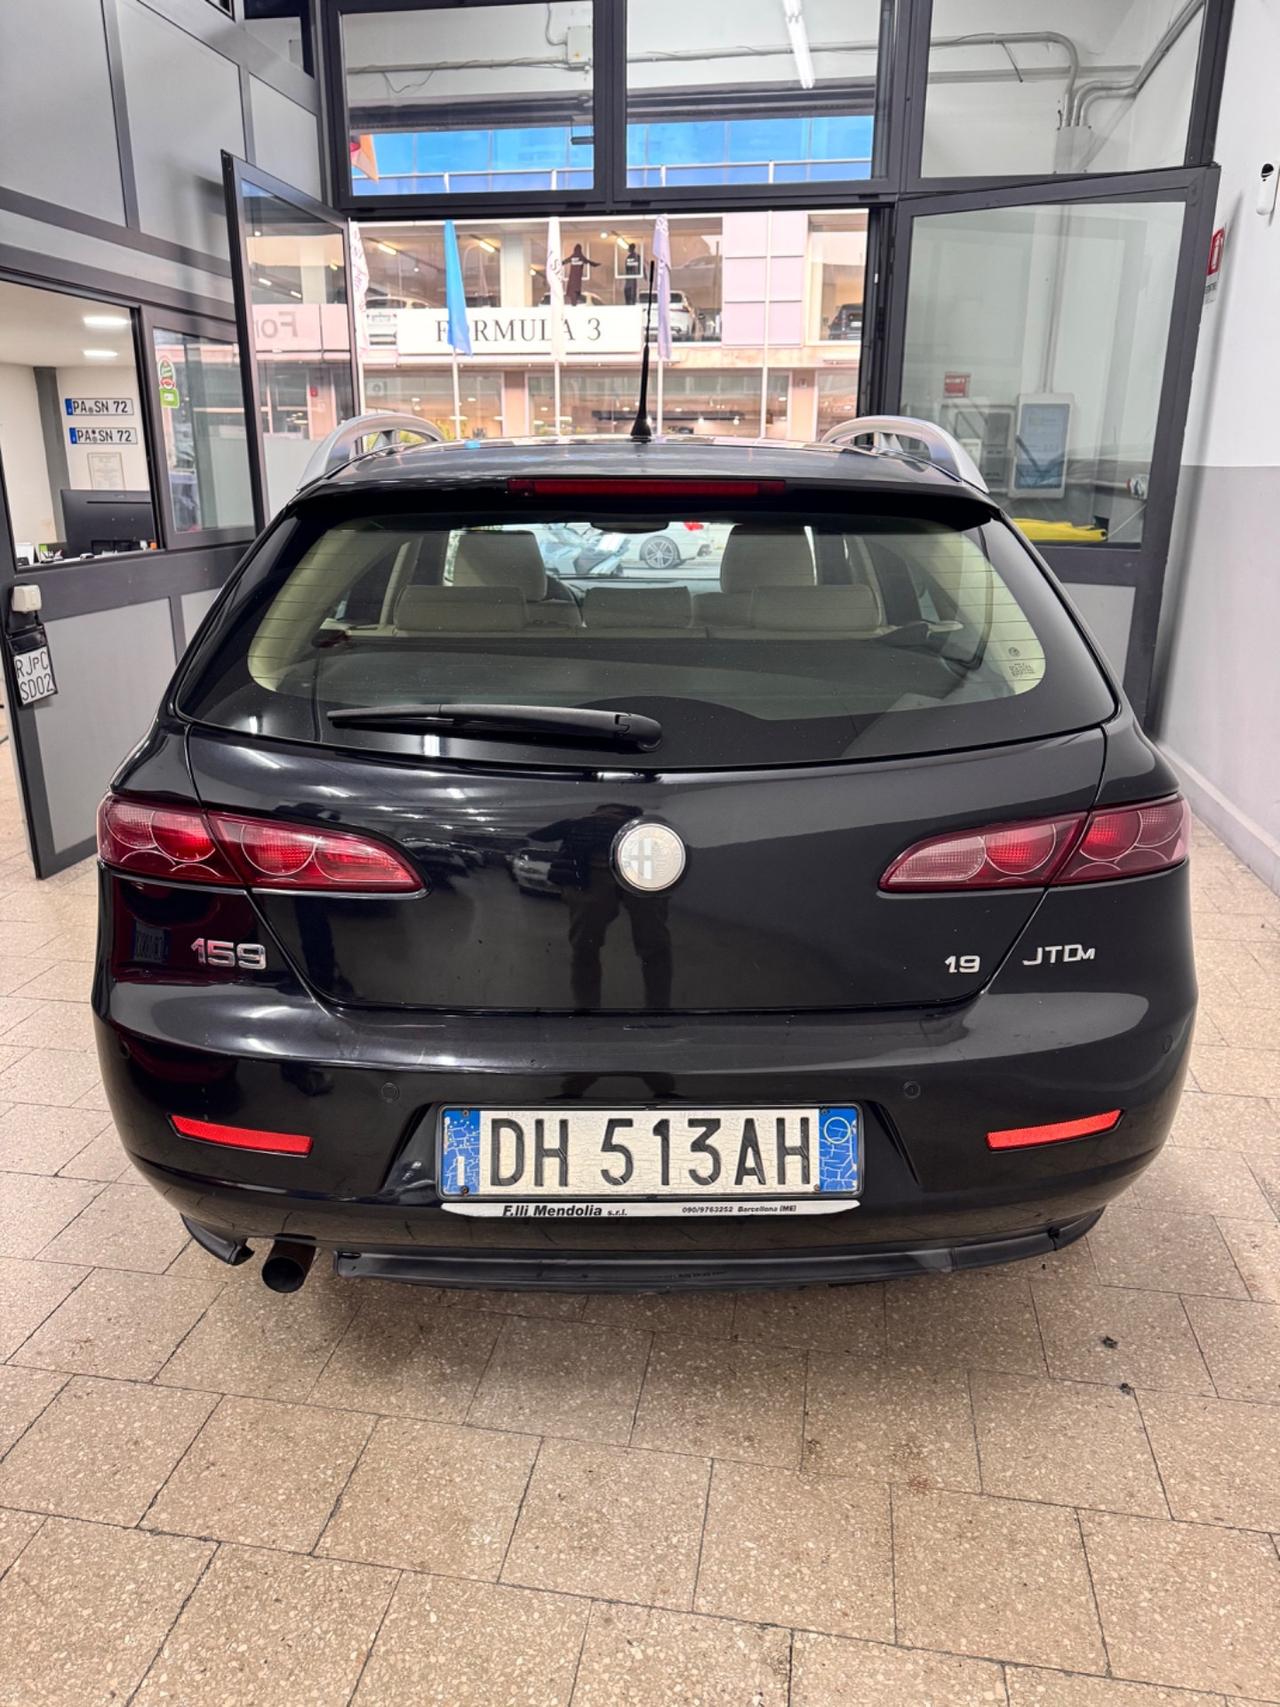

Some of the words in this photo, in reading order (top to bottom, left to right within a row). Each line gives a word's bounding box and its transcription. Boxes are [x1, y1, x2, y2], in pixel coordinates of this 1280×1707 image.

[435, 318, 575, 341] FRMULA
[587, 317, 602, 341] 3
[95, 400, 109, 413] SN
[113, 400, 128, 413] 72
[98, 430, 113, 442] SN
[117, 430, 132, 442] 72
[190, 937, 266, 970] 159
[490, 1118, 569, 1187] DH
[600, 1117, 811, 1186] 513AH
[533, 1204, 603, 1217] Mendolia
[607, 1208, 628, 1216] s.r.l.
[738, 1205, 778, 1213] Barcellona
